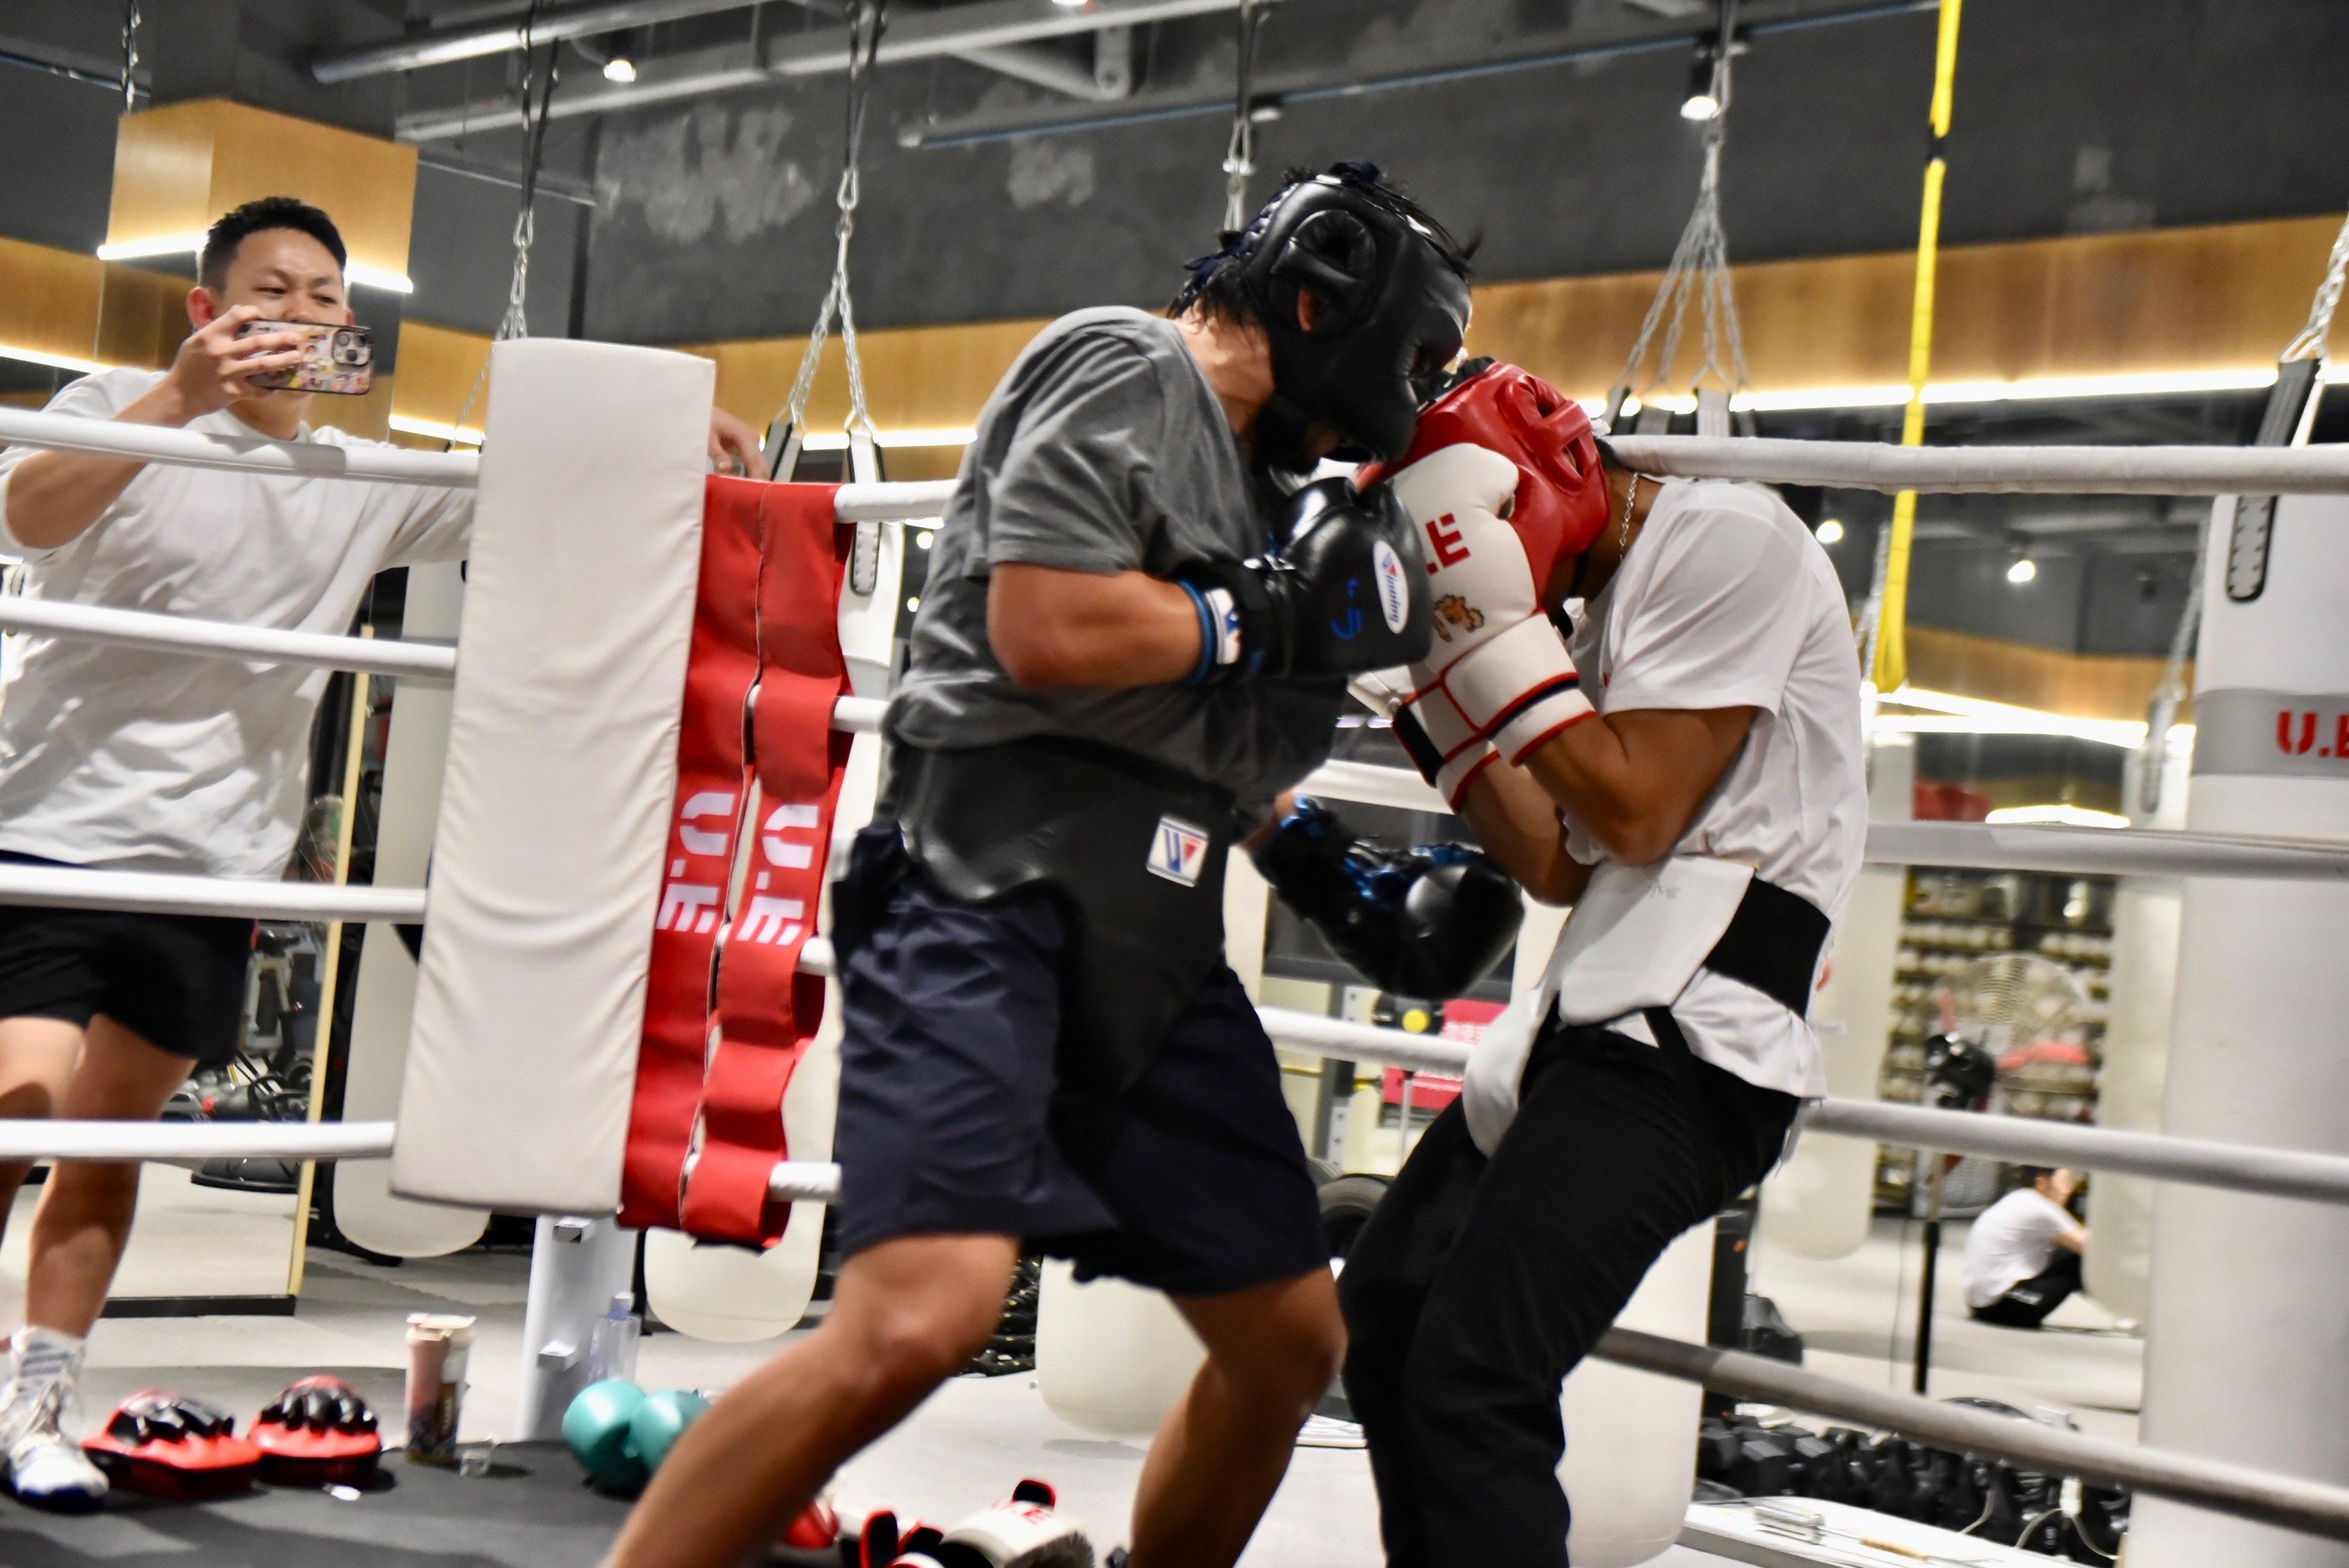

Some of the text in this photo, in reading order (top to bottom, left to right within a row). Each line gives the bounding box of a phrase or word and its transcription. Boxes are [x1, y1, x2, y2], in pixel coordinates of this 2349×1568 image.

[1425, 512, 1471, 574] .E
[655, 792, 734, 934] U.E
[736, 804, 818, 946] U.E
